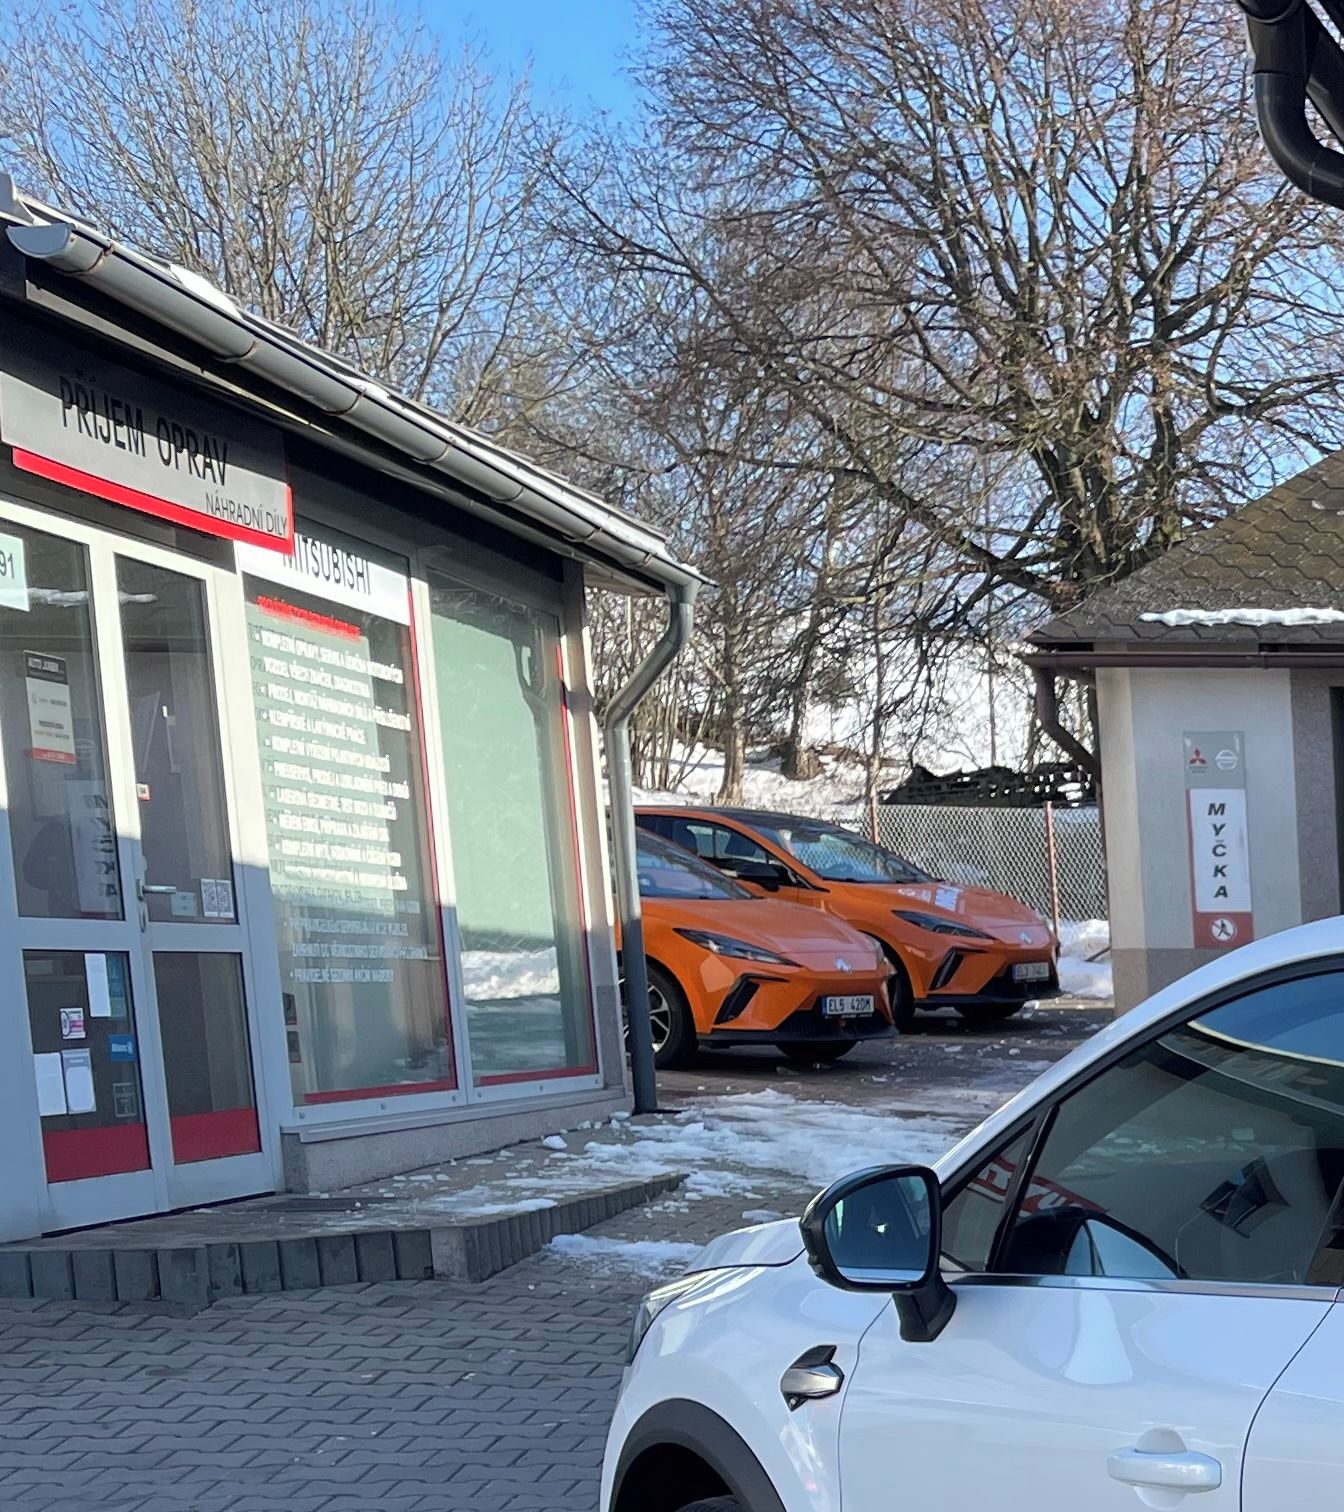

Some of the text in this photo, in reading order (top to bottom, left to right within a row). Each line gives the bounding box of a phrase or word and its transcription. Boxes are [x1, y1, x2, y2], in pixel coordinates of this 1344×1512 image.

[59, 369, 228, 486] PŘÍJEM OPRAV
[205, 490, 288, 540] NÁHRADNÍ DÍLY
[282, 533, 371, 596] MITSUBISHI
[1207, 802, 1229, 899] MYČKA
